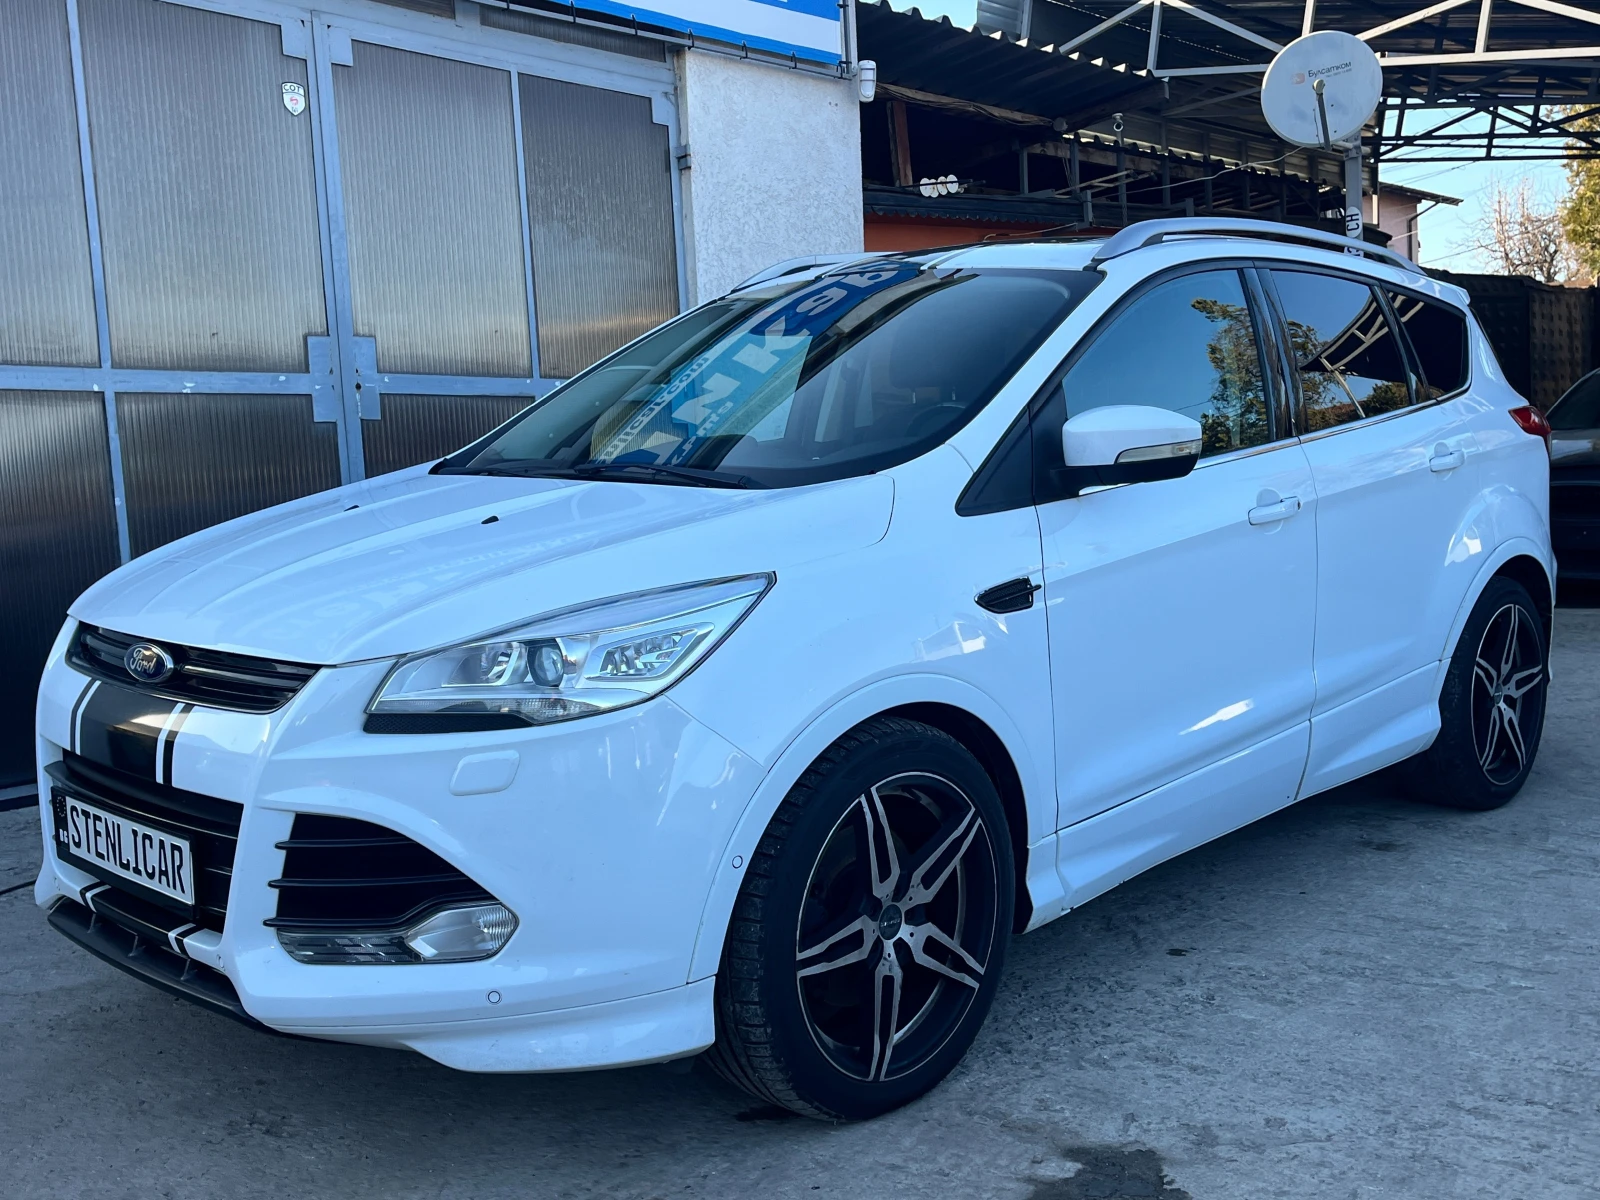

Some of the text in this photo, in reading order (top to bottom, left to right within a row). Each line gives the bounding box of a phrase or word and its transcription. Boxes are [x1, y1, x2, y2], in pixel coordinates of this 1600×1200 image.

[1308, 62, 1351, 77] Булсатком
[130, 648, 157, 674] Ford
[70, 805, 185, 894] STENLICAR
